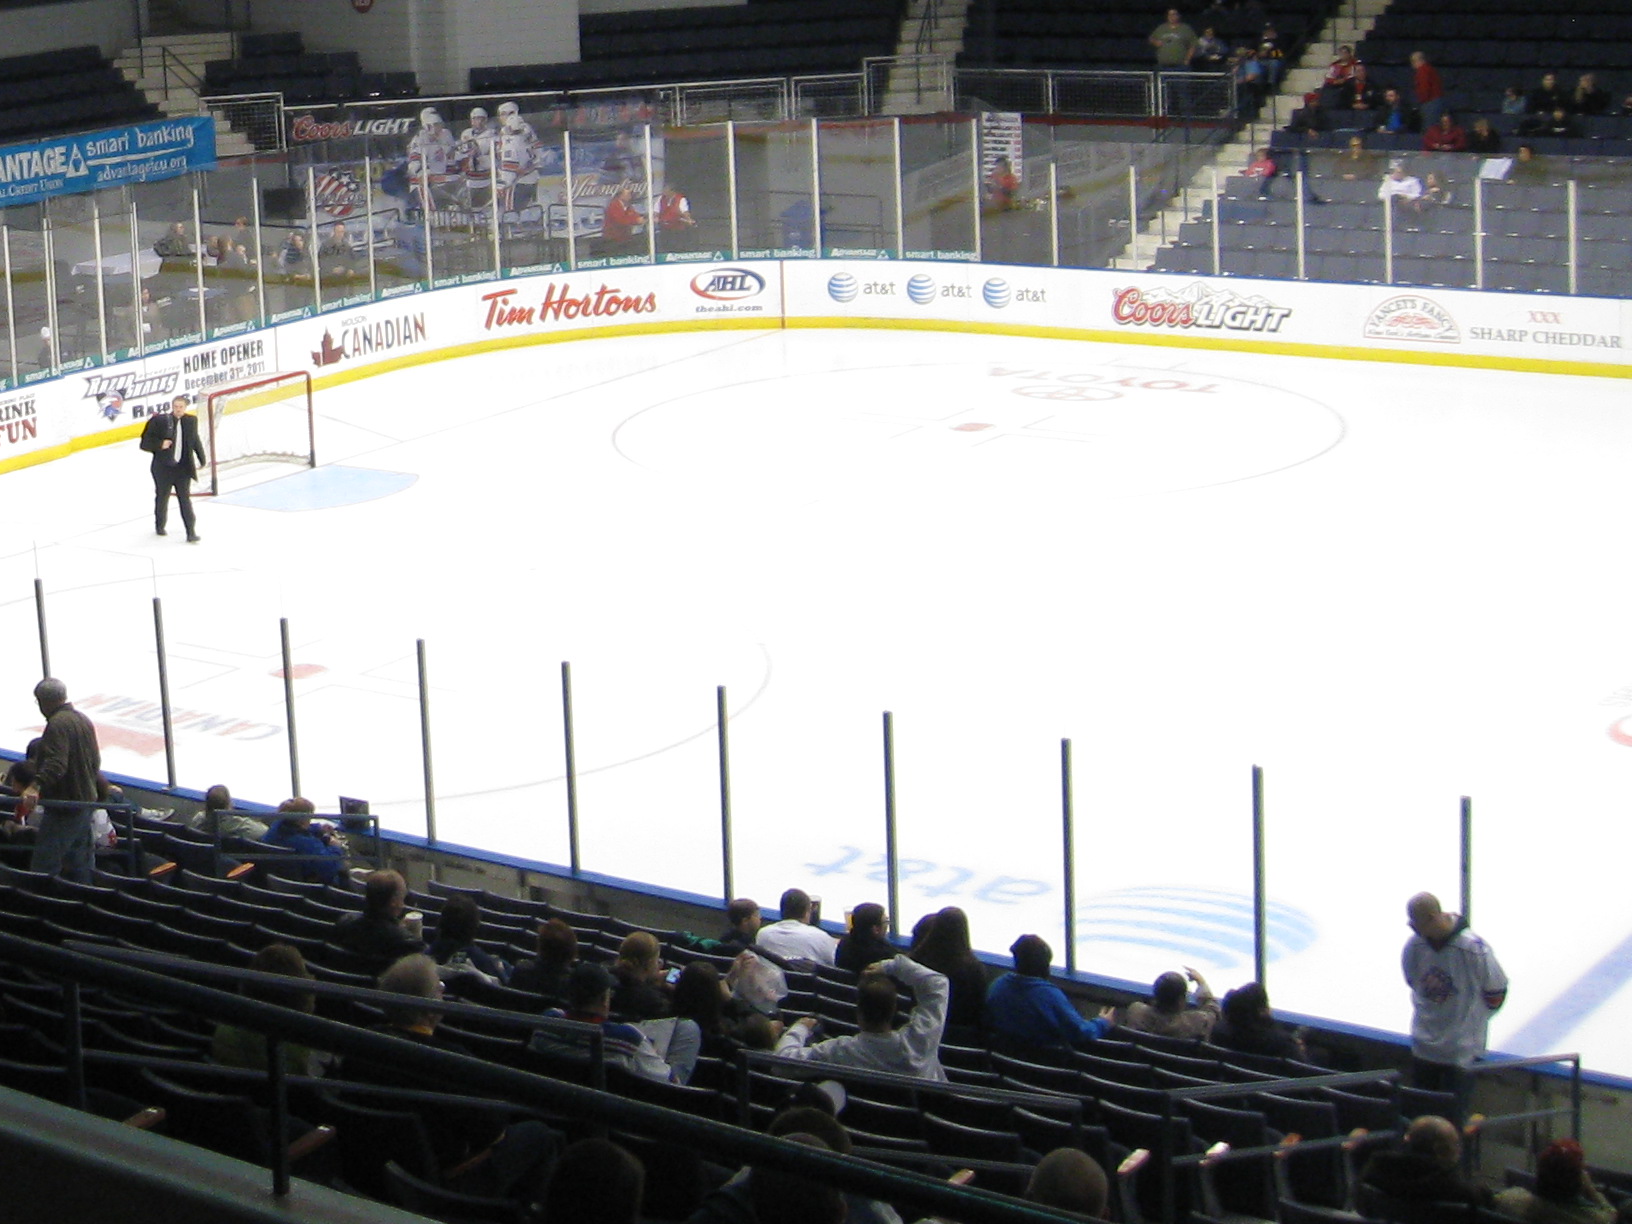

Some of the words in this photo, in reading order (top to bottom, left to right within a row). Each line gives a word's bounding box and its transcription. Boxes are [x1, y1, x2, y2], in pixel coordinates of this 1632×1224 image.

[293, 115, 352, 141] Coors
[353, 117, 416, 136] LIGHT
[86, 132, 130, 156] smart
[135, 125, 194, 148] banking
[578, 258, 607, 269] smart
[610, 255, 651, 266] banking
[739, 249, 770, 258] smart
[774, 247, 815, 259] banking
[434, 275, 460, 288] smart
[462, 272, 495, 283] banking
[703, 275, 752, 292] AHL
[863, 280, 896, 296] at&t
[941, 283, 972, 299] at&t
[1016, 287, 1046, 303] at&t
[482, 288, 536, 330] Tim
[539, 282, 656, 322] Hortons
[1112, 286, 1196, 328] Coors
[1195, 303, 1292, 332] LIGHT
[1528, 310, 1562, 324] XXX
[342, 312, 426, 359] CANADIAN
[1470, 327, 1527, 343] SHARP
[1533, 331, 1622, 348] CHEDDAR
[184, 354, 217, 374] HOME
[220, 339, 264, 365] OPENER
[184, 374, 228, 391] December
[247, 360, 265, 375] 2011
